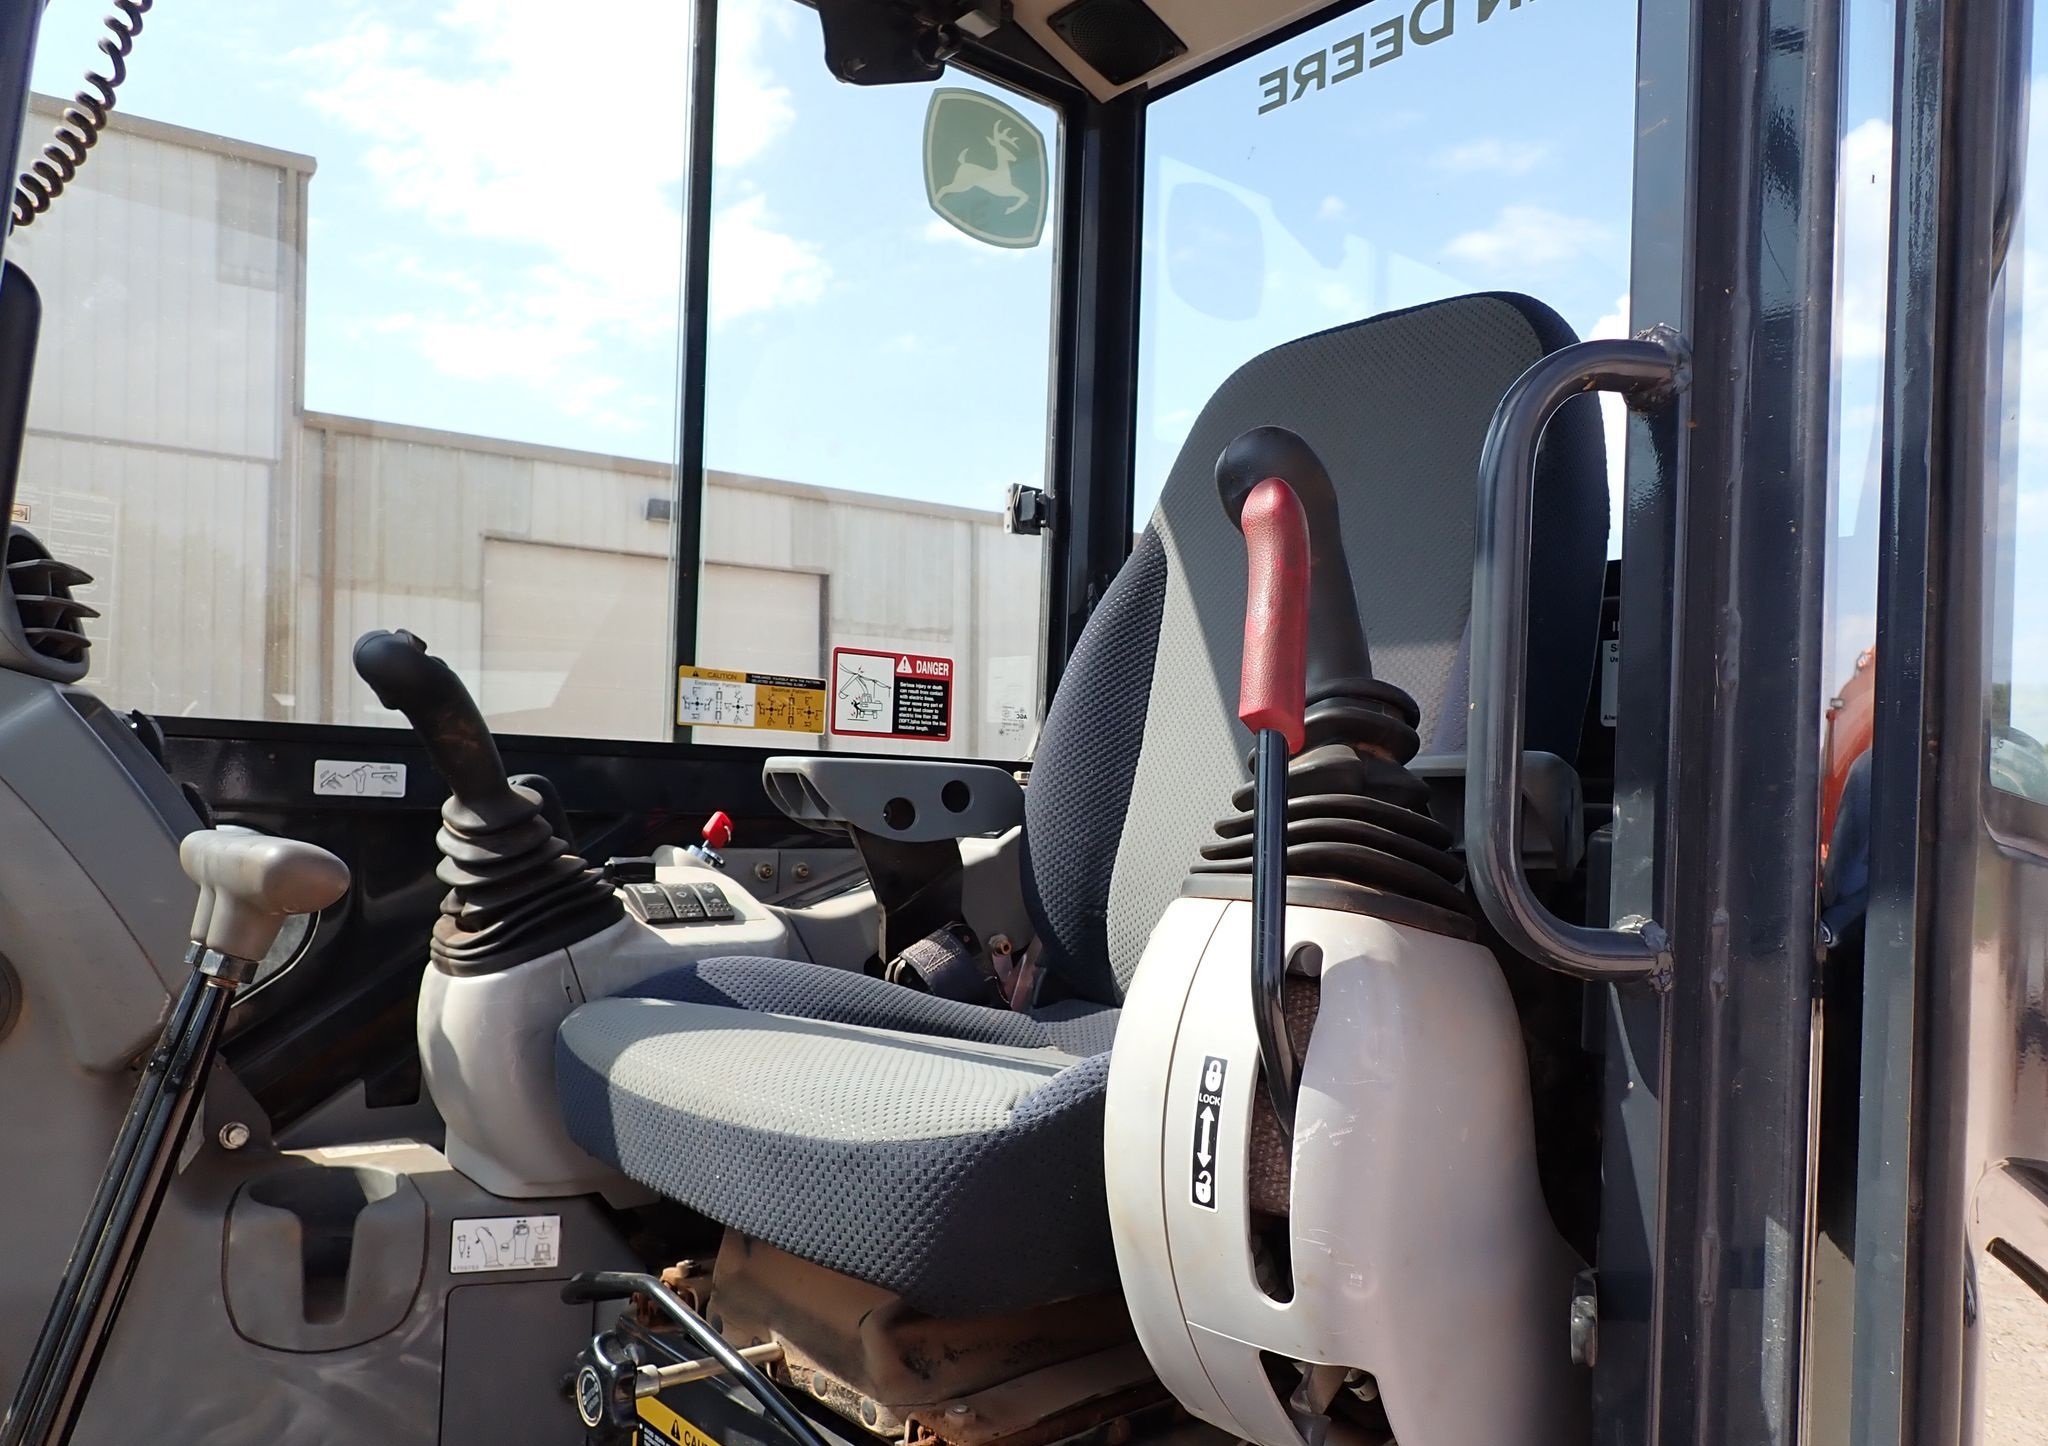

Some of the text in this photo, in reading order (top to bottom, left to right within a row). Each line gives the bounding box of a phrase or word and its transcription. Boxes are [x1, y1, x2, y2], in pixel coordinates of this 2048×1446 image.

[916, 660, 949, 676] DANGER
[707, 672, 737, 680] CAUTION
[1199, 1093, 1220, 1106] LOCK
